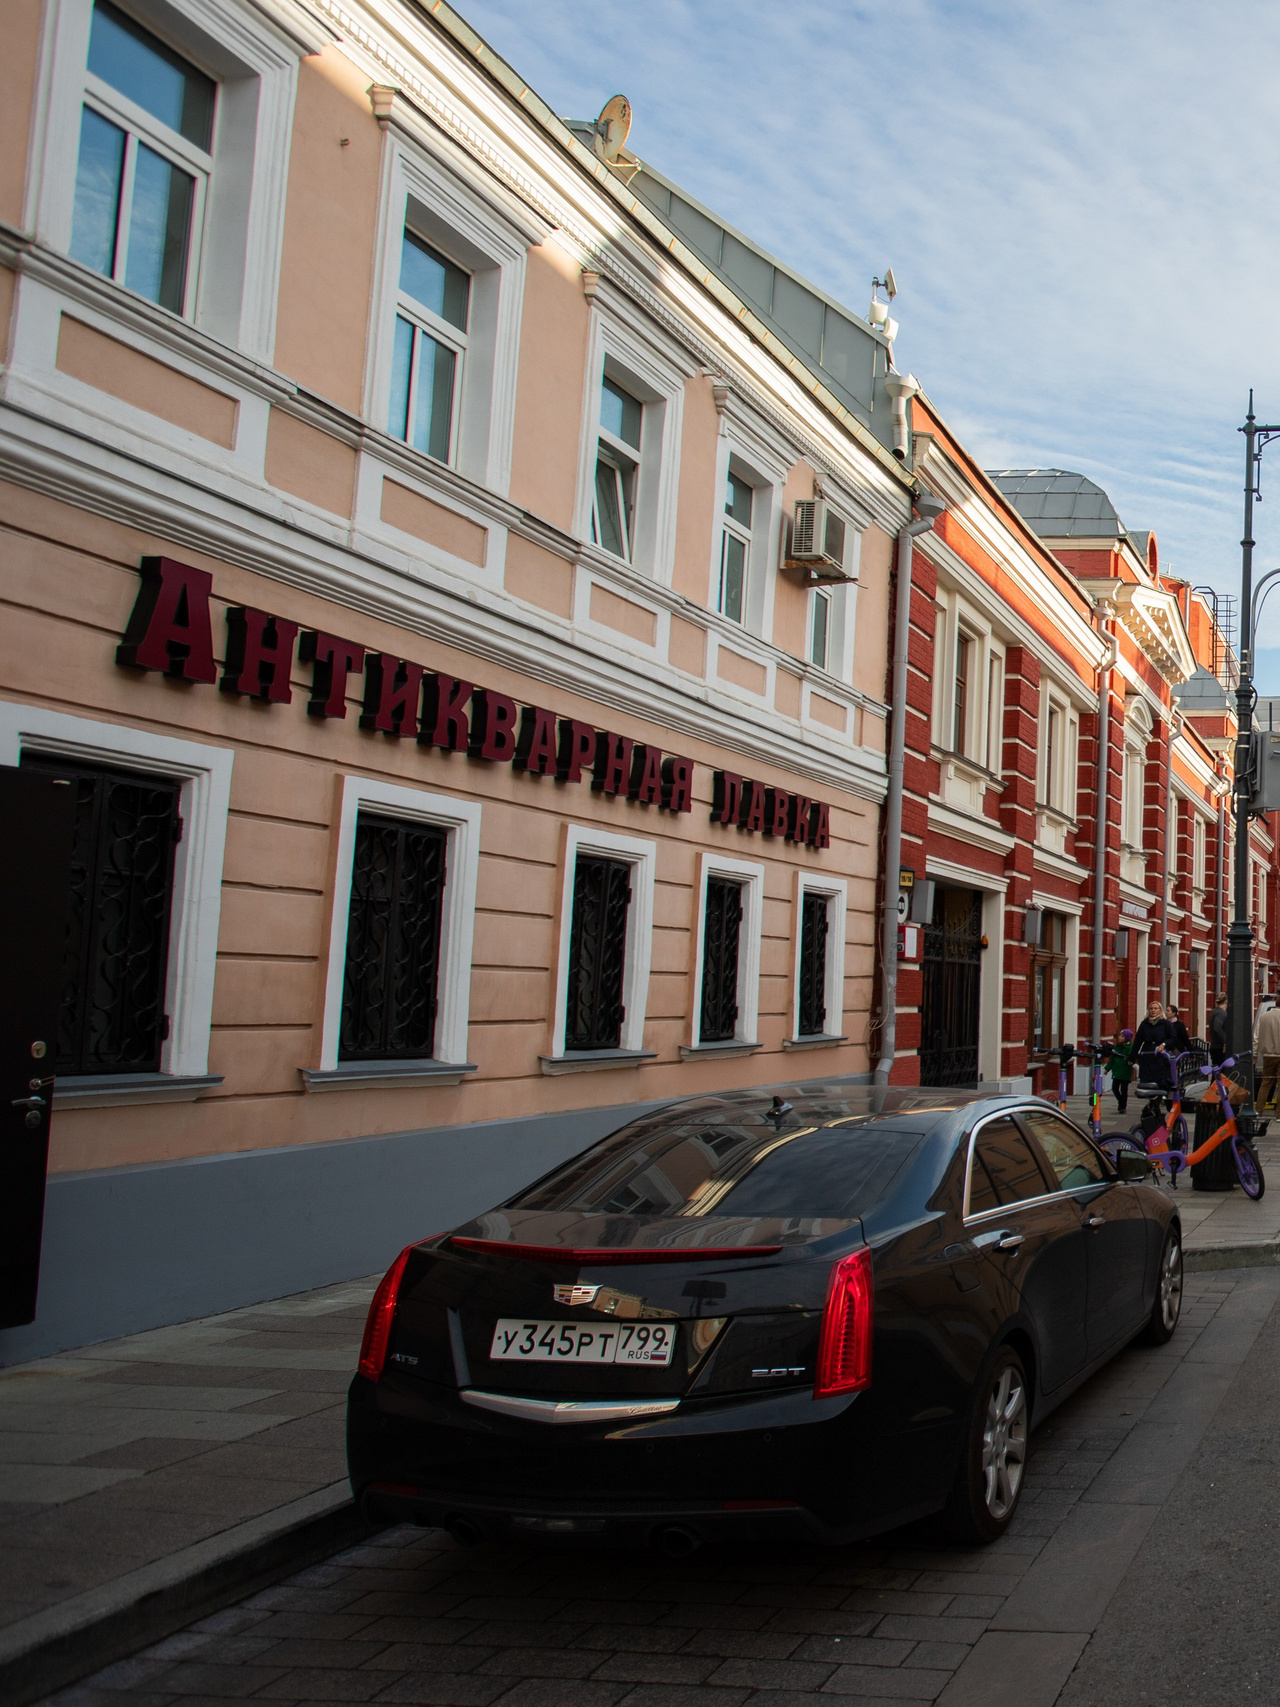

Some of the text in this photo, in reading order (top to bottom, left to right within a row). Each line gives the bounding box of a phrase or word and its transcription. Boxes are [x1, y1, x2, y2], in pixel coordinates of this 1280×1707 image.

[113, 555, 831, 849] АНТИКВАРНАЯ ЛАВКА
[621, 1326, 667, 1350] 799
[390, 1353, 419, 1365] ATS
[627, 1350, 650, 1360] RUS
[751, 1367, 806, 1378] 2.0T
